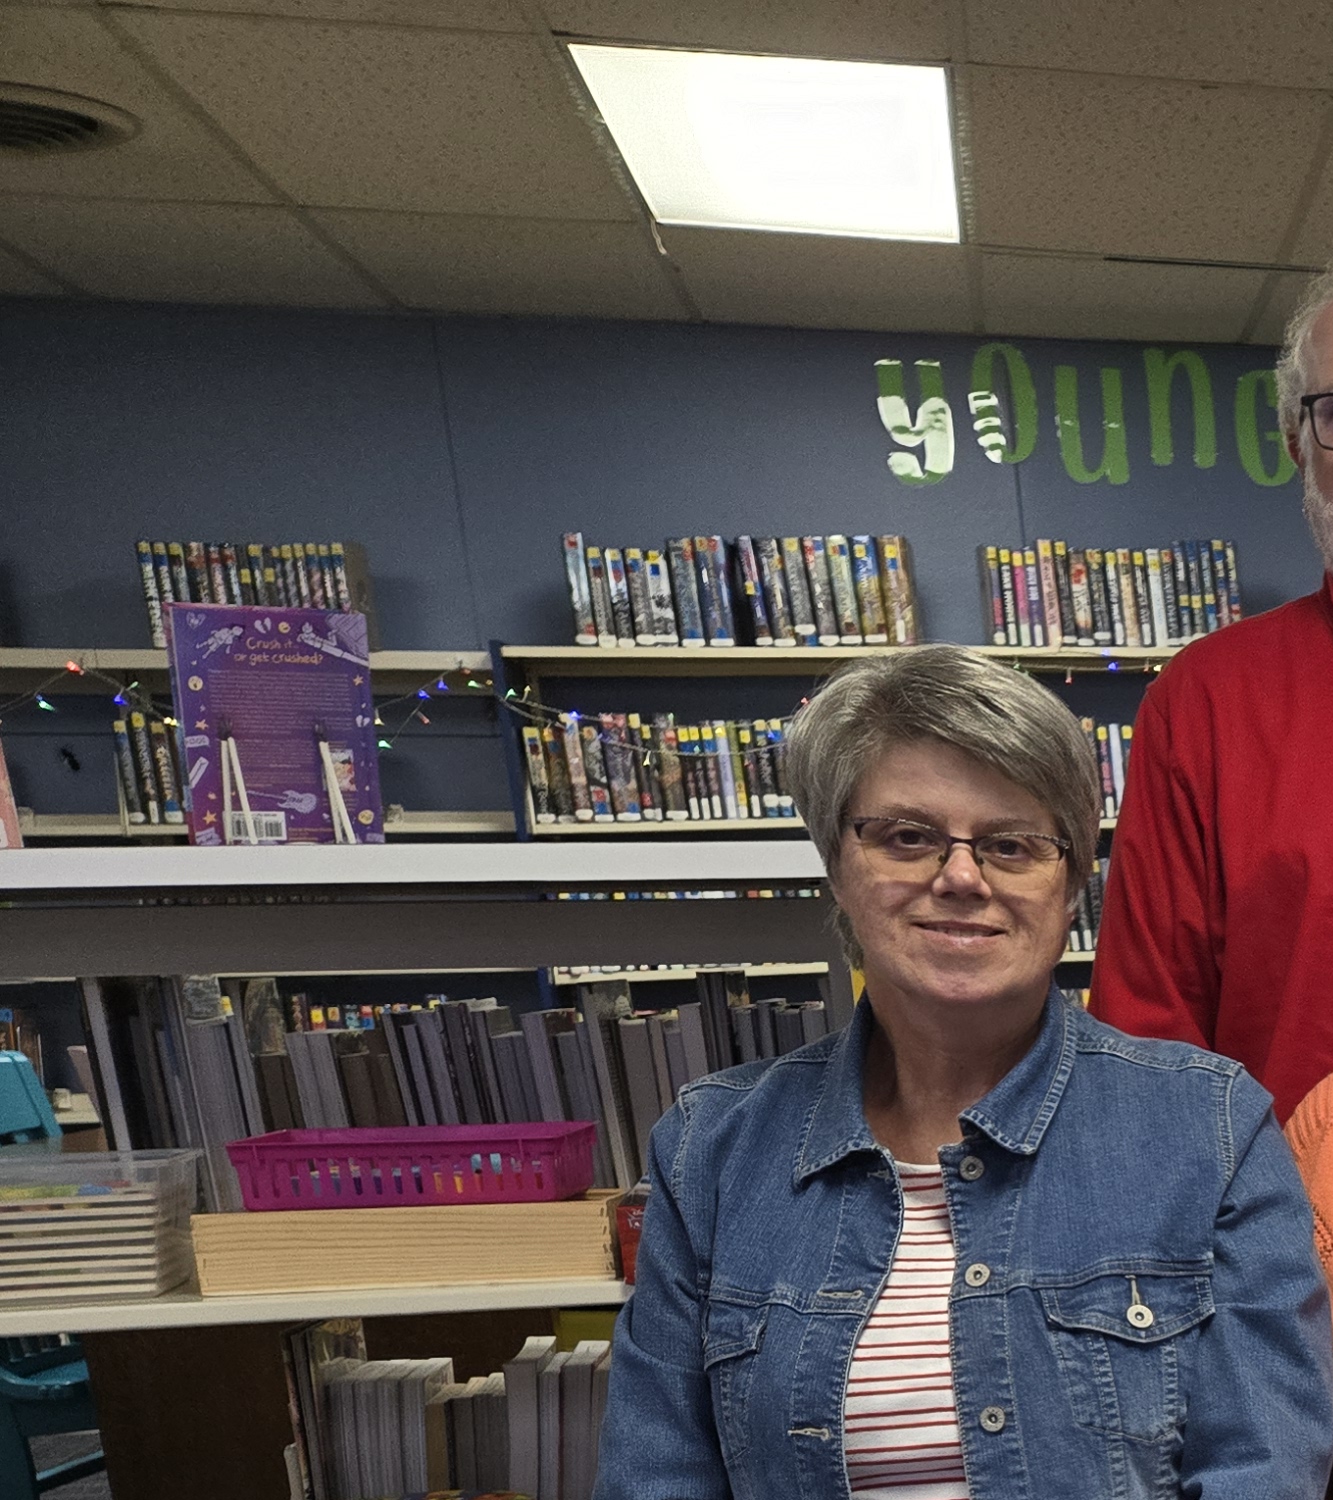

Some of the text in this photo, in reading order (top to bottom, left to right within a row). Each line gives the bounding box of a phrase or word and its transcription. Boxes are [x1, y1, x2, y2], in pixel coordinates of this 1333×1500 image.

[246, 636, 281, 650] Crush
[234, 653, 324, 666] or get crushed?
